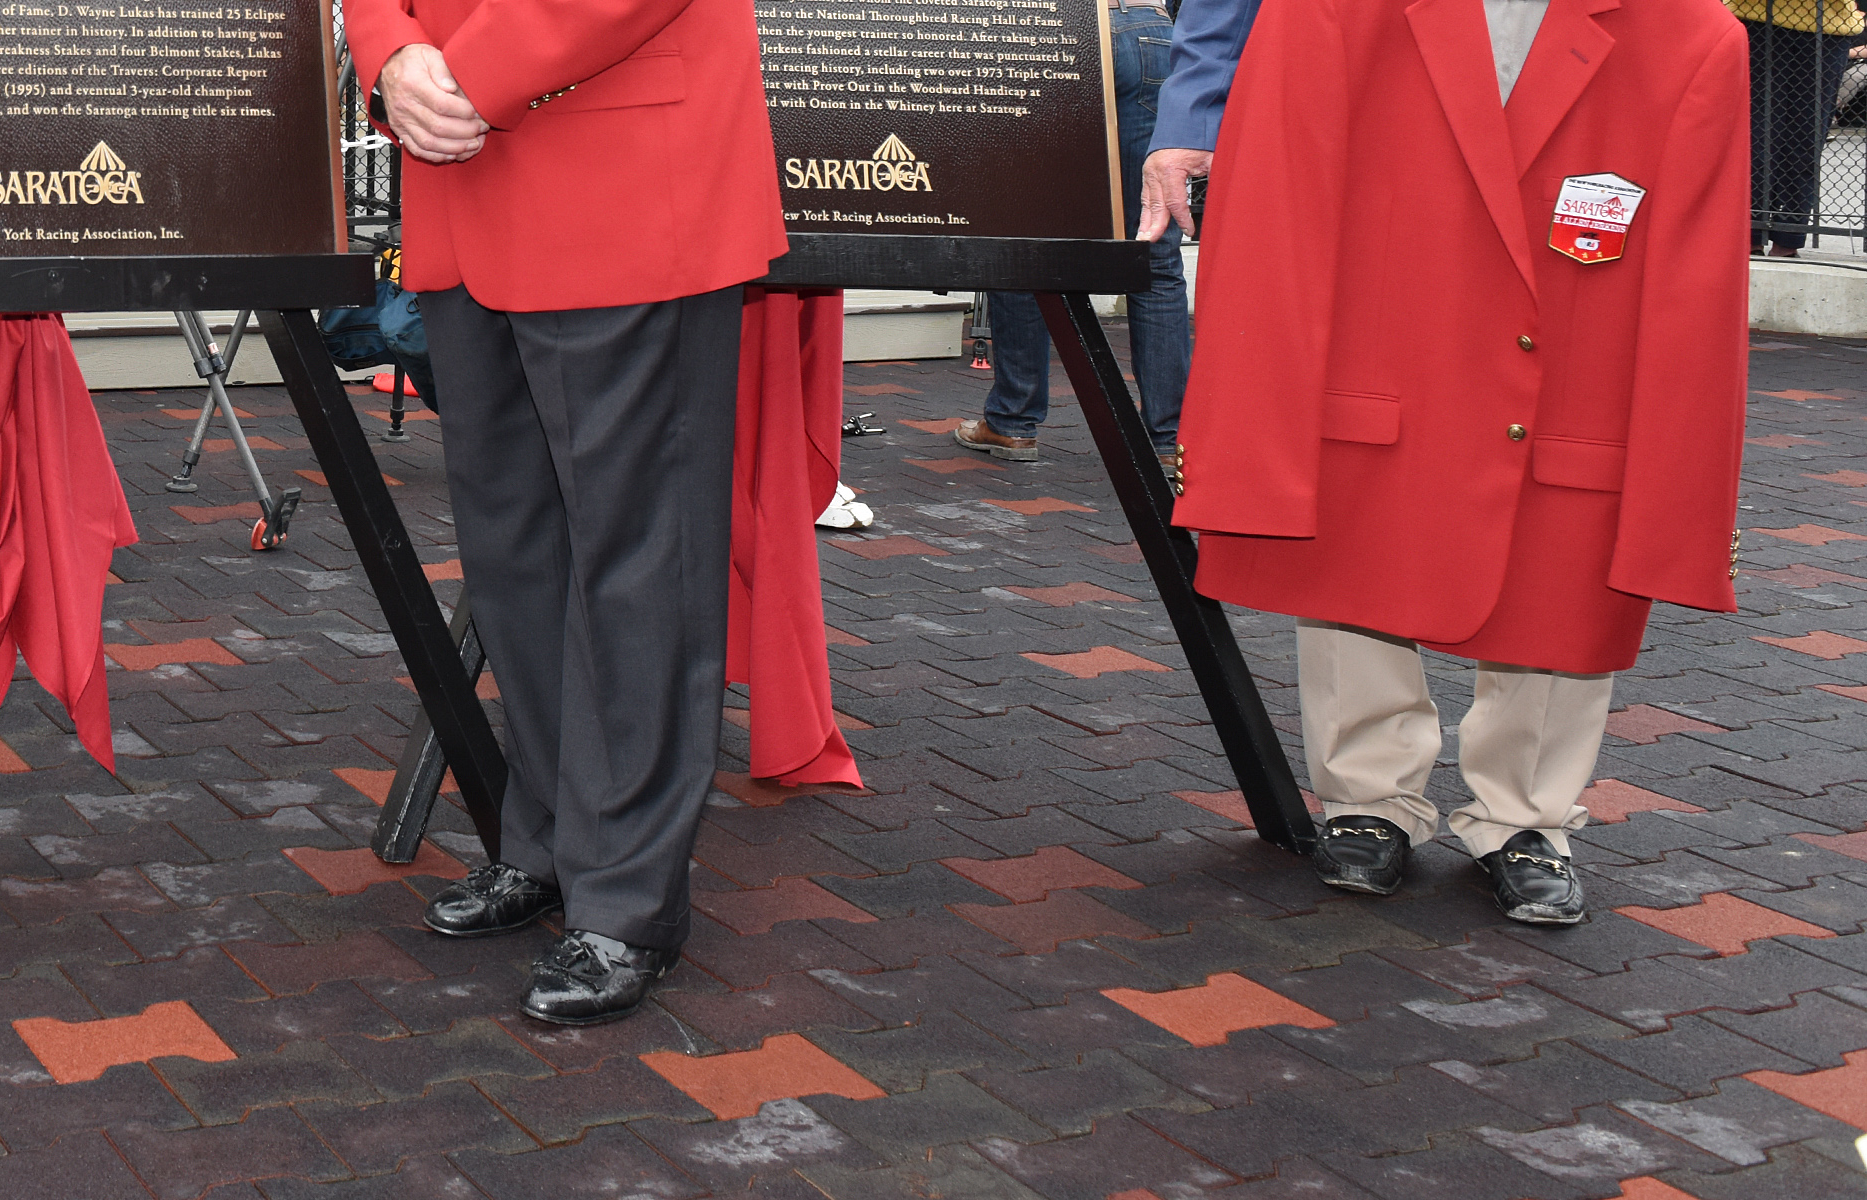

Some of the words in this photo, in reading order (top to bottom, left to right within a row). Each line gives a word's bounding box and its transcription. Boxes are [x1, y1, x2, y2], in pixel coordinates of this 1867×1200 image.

[2, 3, 16, 16] of
[18, 4, 54, 17] Fame,
[58, 5, 73, 16] D.
[76, 5, 116, 20] Wayne
[119, 6, 154, 18] Lukas
[158, 6, 177, 18] has
[181, 7, 223, 19] trained
[226, 9, 241, 20] 25
[245, 8, 285, 23] Eclipse
[1012, 0, 1057, 12] training
[20, 25, 62, 36] trainer
[66, 25, 78, 36] in
[82, 24, 128, 40] history.
[131, 26, 144, 37] In
[148, 25, 198, 38] addition
[202, 30, 214, 38] to
[218, 27, 257, 42] having
[757, 24, 783, 36] then
[786, 25, 804, 36] the
[806, 30, 857, 41] youngest
[860, 29, 899, 39] trainer
[902, 32, 914, 40] so
[917, 29, 967, 41] honored.
[970, 31, 999, 42] After
[1002, 32, 1037, 47] taking
[1061, 34, 1078, 44] his
[761, 43, 803, 55] Jerkens
[806, 43, 861, 56] fashioned
[874, 46, 908, 57] stellar
[911, 50, 945, 58] career
[948, 48, 971, 59] that
[973, 52, 994, 60] was
[997, 51, 1059, 63] punctuated
[1062, 51, 1075, 65] by
[785, 158, 934, 192] SARATOGA
[781, 210, 800, 221] ew
[802, 210, 830, 221] York
[833, 211, 873, 226] Racing
[875, 212, 945, 225] Association,
[947, 213, 970, 225] Inc.
[1562, 199, 1627, 221] SARATOGA
[3, 228, 33, 240] York
[36, 228, 80, 243] Racing
[82, 228, 157, 240] Association,
[160, 227, 184, 239] Inc.
